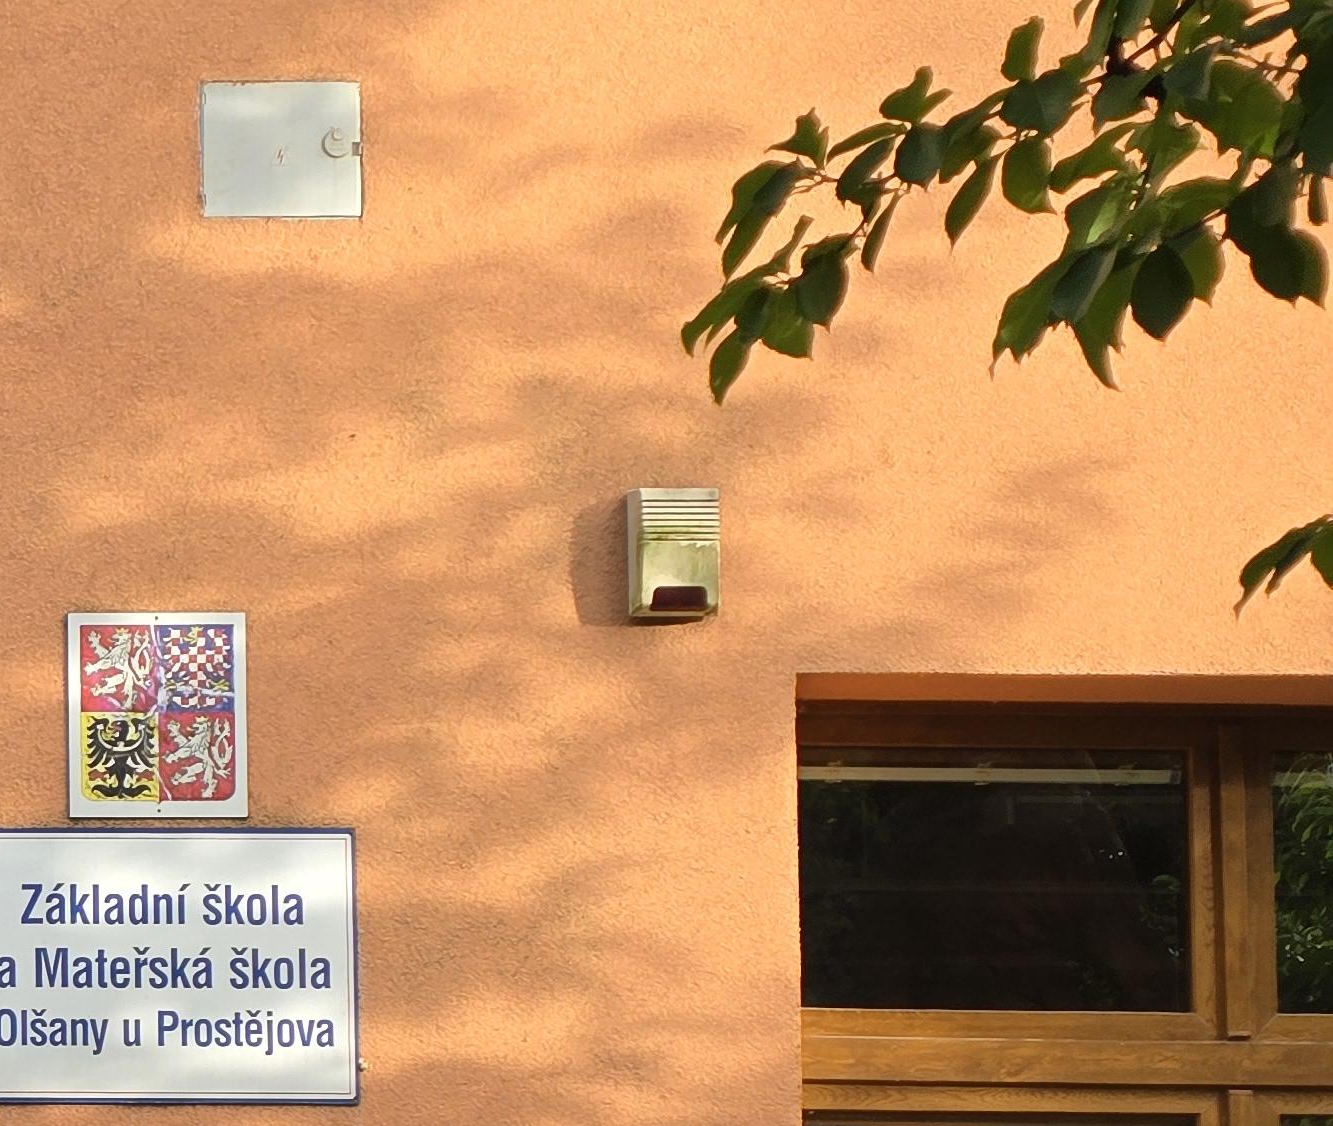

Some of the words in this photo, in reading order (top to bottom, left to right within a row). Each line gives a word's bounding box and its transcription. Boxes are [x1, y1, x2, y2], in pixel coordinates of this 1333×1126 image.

[20, 882, 191, 926] Základní
[202, 883, 304, 926] škola
[34, 946, 213, 989] Mateřská
[229, 947, 332, 990] škola
[124, 1018, 141, 1047] u
[157, 1009, 335, 1056] Prostějova
